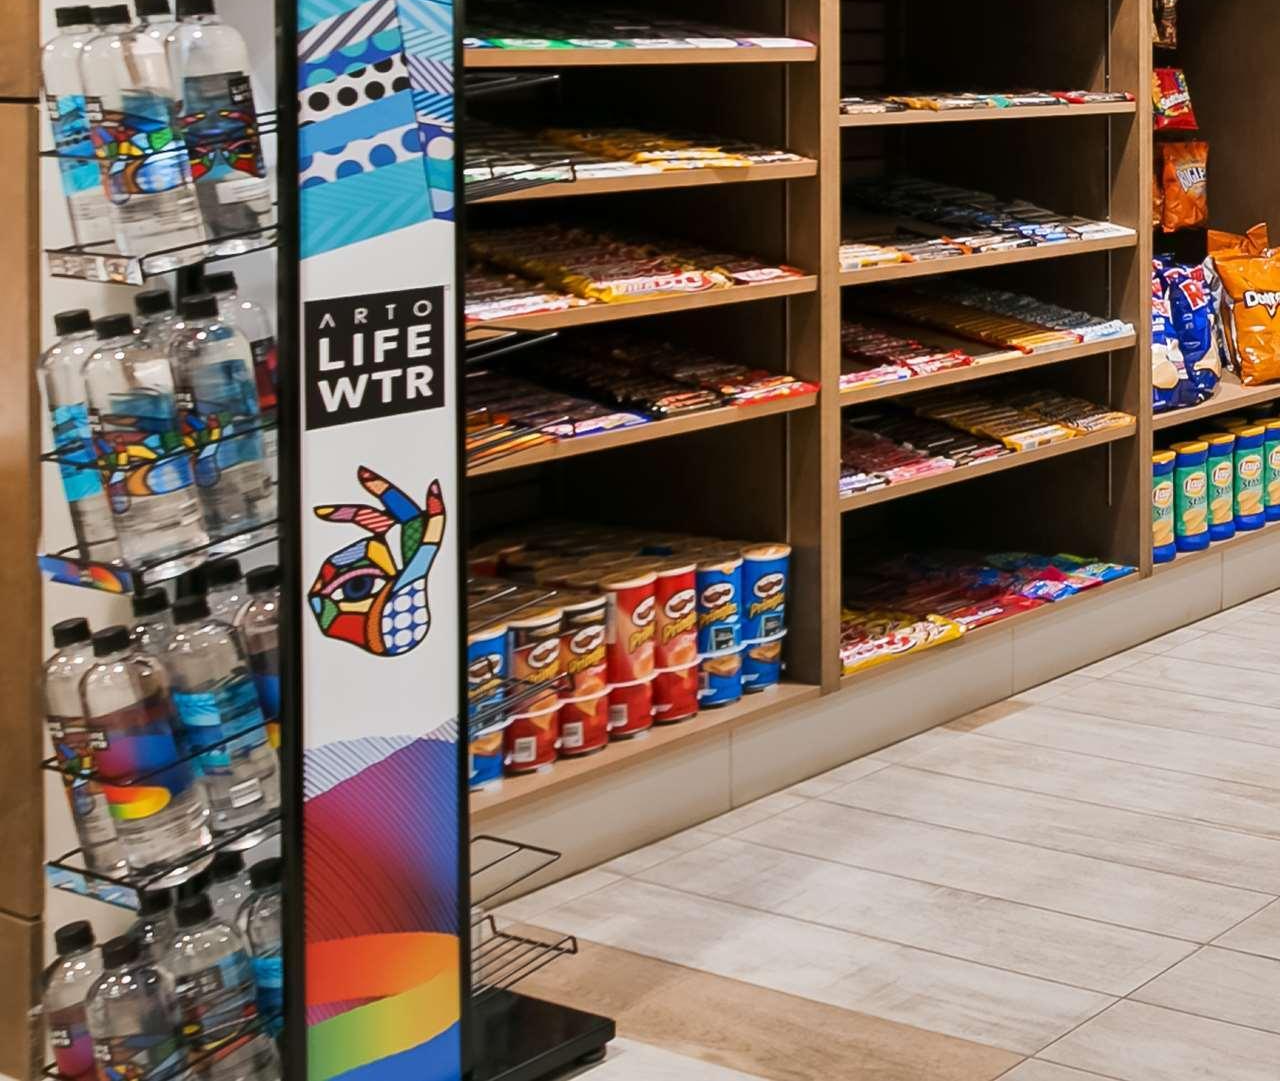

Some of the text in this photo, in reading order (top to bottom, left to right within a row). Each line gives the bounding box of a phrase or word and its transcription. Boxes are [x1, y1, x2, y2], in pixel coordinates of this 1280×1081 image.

[319, 301, 433, 330] ARTO
[319, 324, 433, 371] LIFE
[318, 365, 434, 413] WTR
